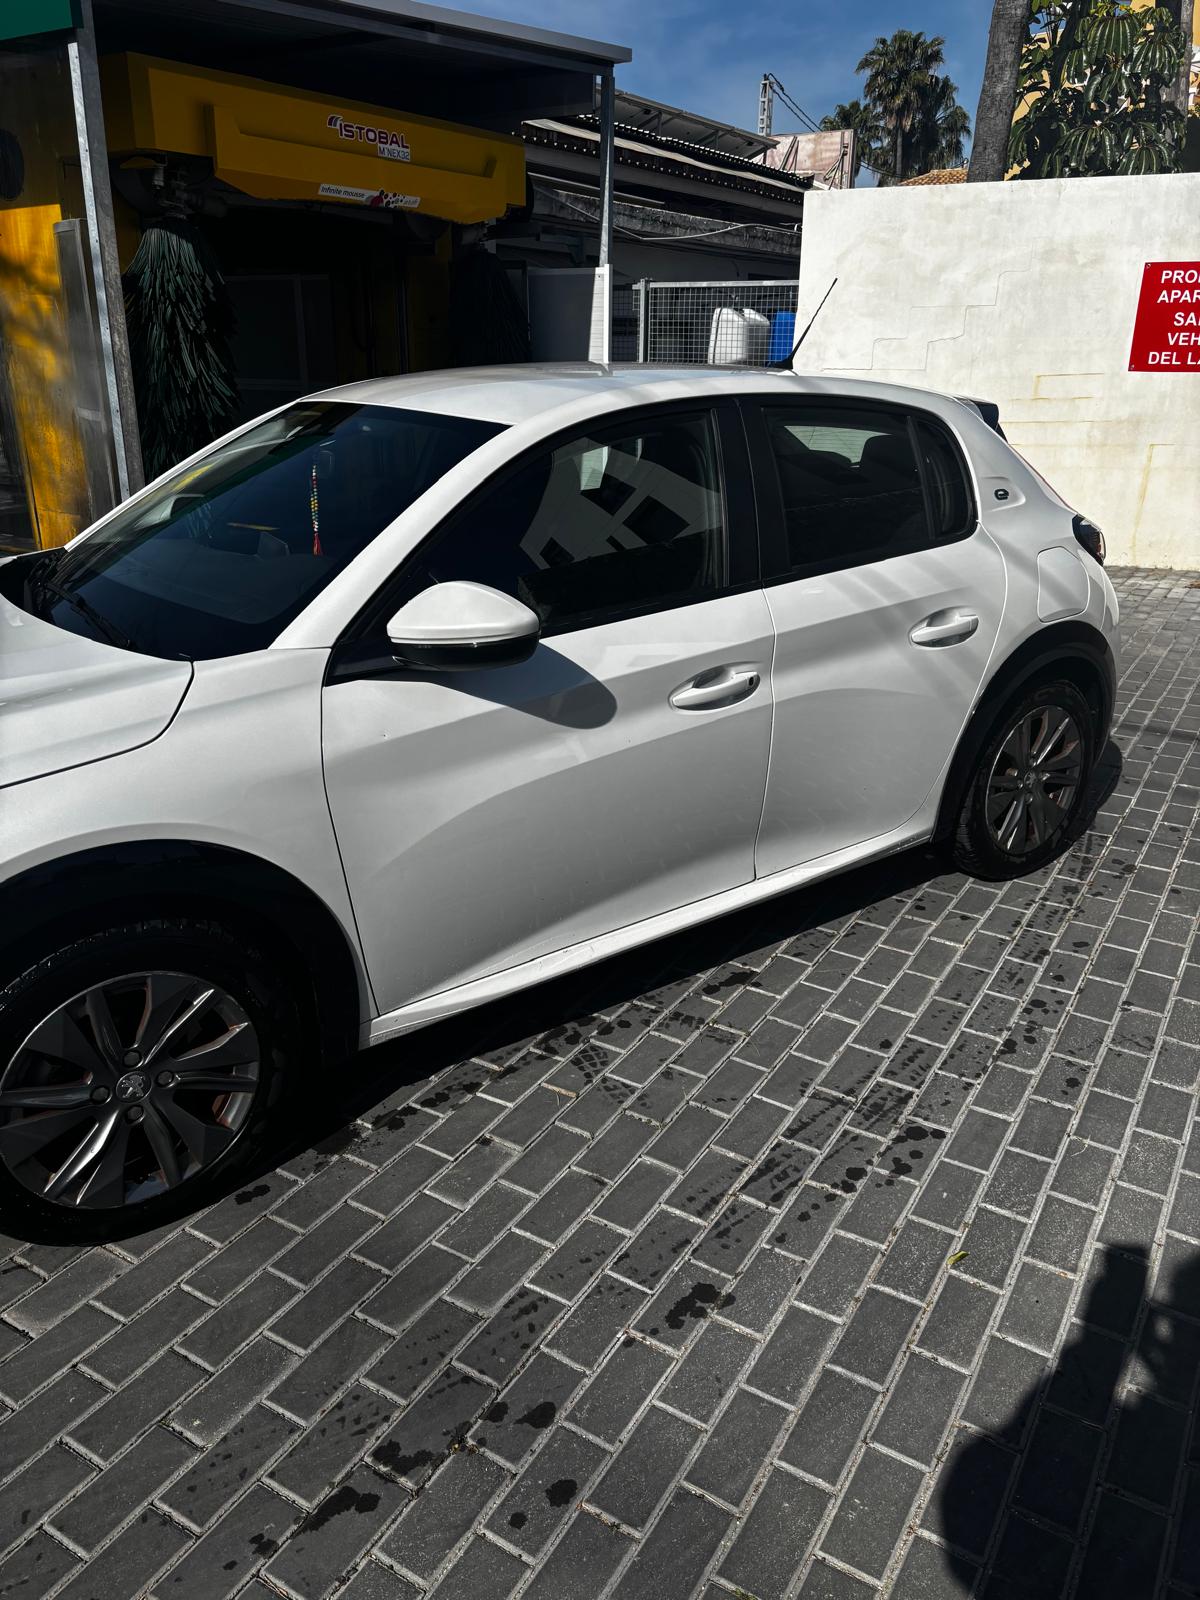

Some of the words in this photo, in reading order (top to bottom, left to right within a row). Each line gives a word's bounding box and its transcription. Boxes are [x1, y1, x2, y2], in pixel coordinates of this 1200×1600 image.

[339, 123, 409, 148] ISTOBAL
[342, 190, 365, 199] mousse
[1161, 270, 1200, 283] PRO
[1174, 312, 1200, 326] SA
[1148, 351, 1181, 364] DEL
[1187, 351, 1200, 364] L
